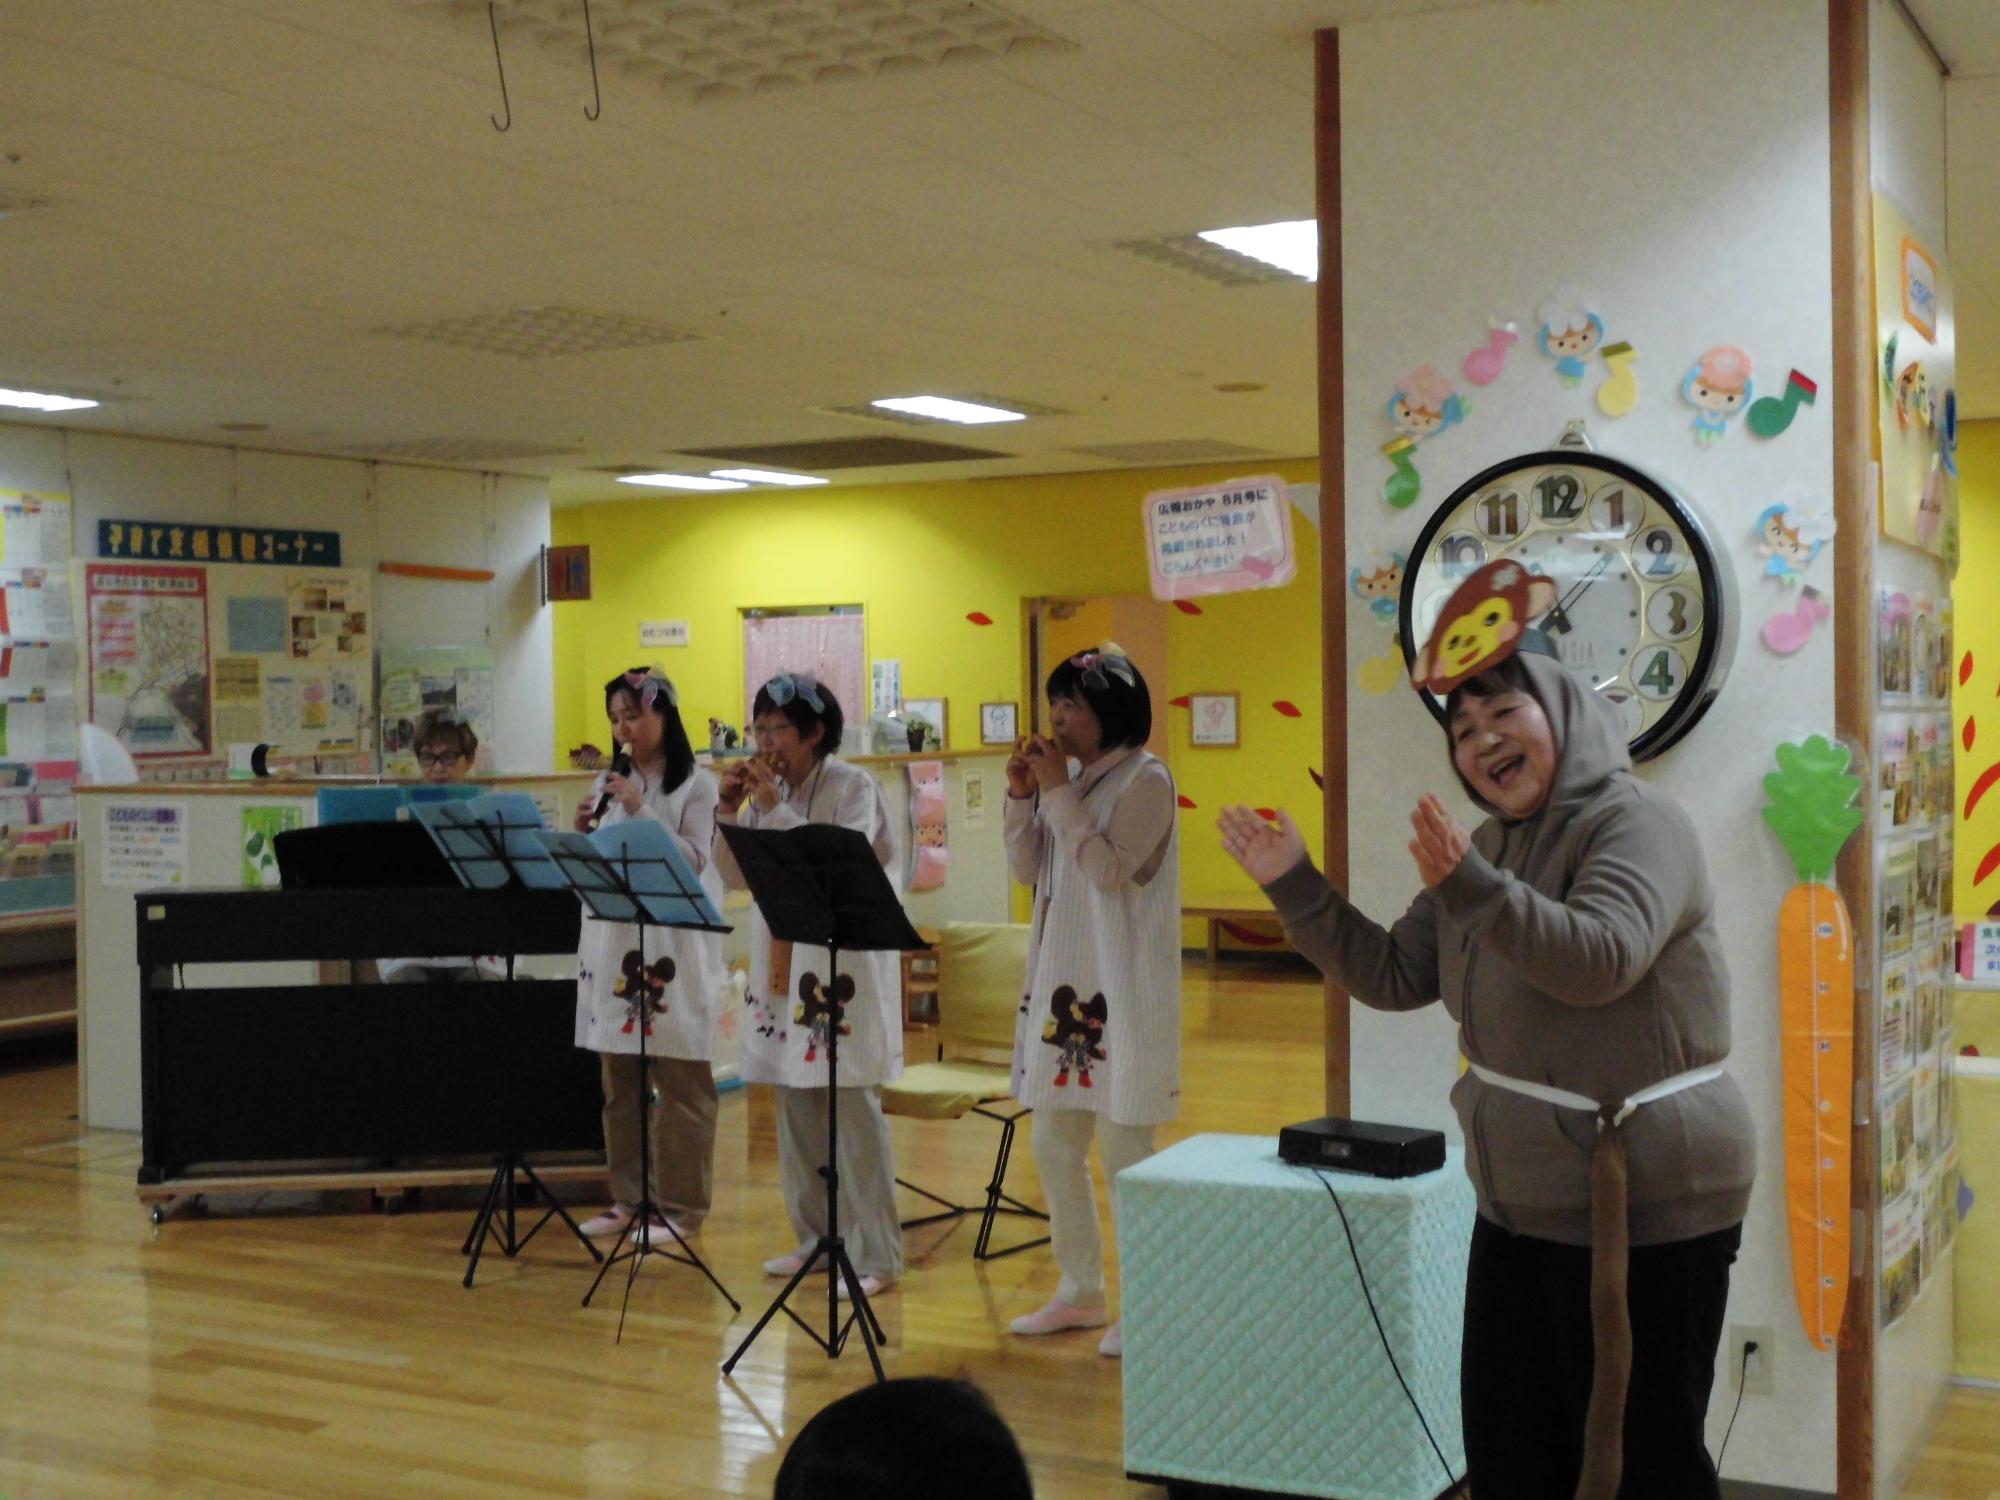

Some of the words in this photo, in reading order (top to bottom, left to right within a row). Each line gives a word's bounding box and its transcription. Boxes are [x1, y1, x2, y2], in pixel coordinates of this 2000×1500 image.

[1481, 491, 1518, 535] 11
[1536, 474, 1582, 518] 12
[1603, 489, 1624, 528] 1
[1439, 535, 1488, 577] 10
[1645, 530, 1676, 575] 2
[1667, 591, 1686, 635] 3
[1638, 651, 1674, 694] 4
